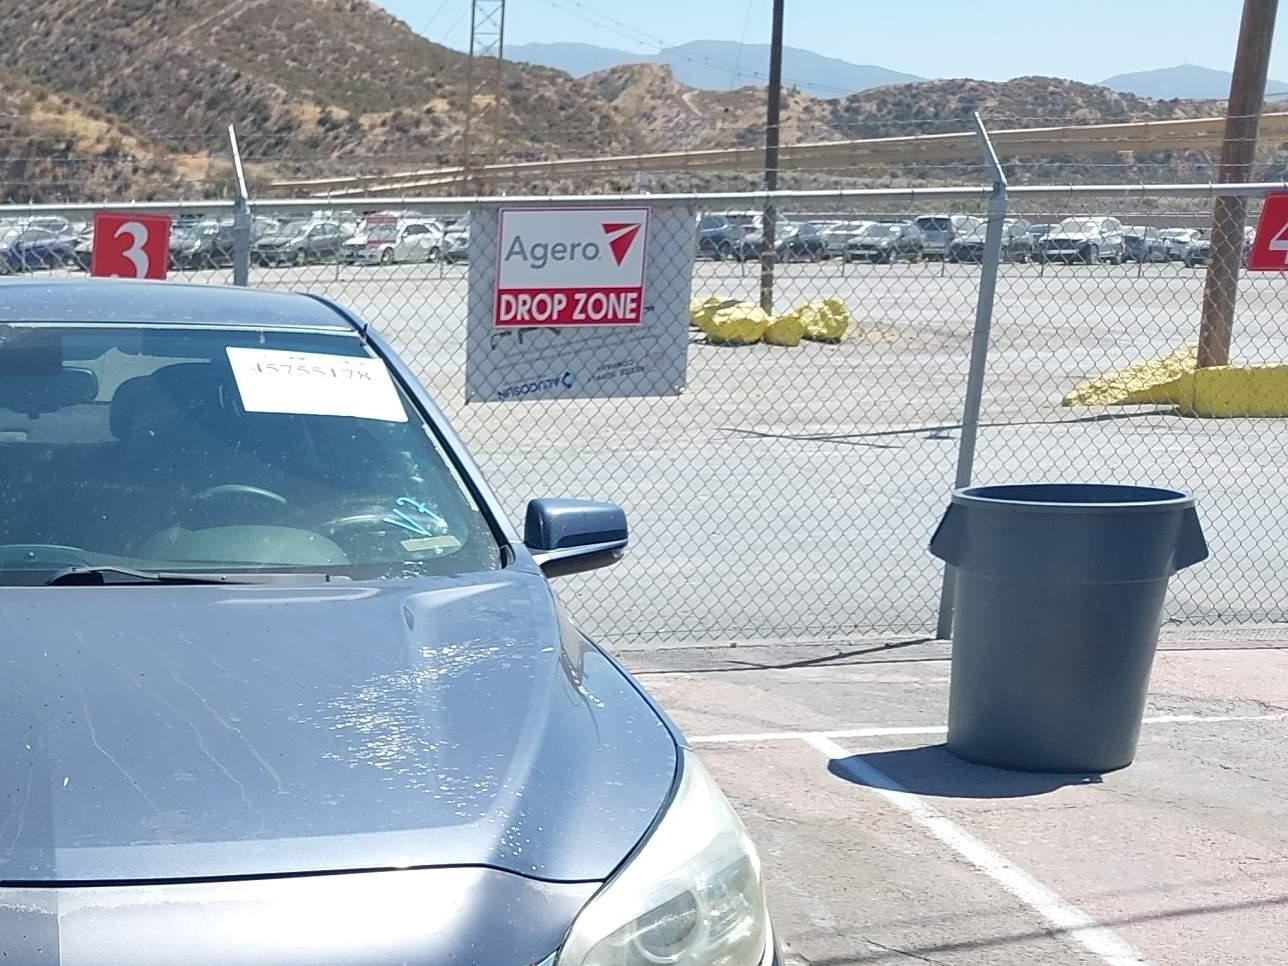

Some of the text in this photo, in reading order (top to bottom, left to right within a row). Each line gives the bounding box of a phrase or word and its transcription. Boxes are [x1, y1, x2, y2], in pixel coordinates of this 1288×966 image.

[113, 221, 150, 280] 3
[504, 234, 600, 270] Agero
[499, 291, 639, 321] DROP ZONE
